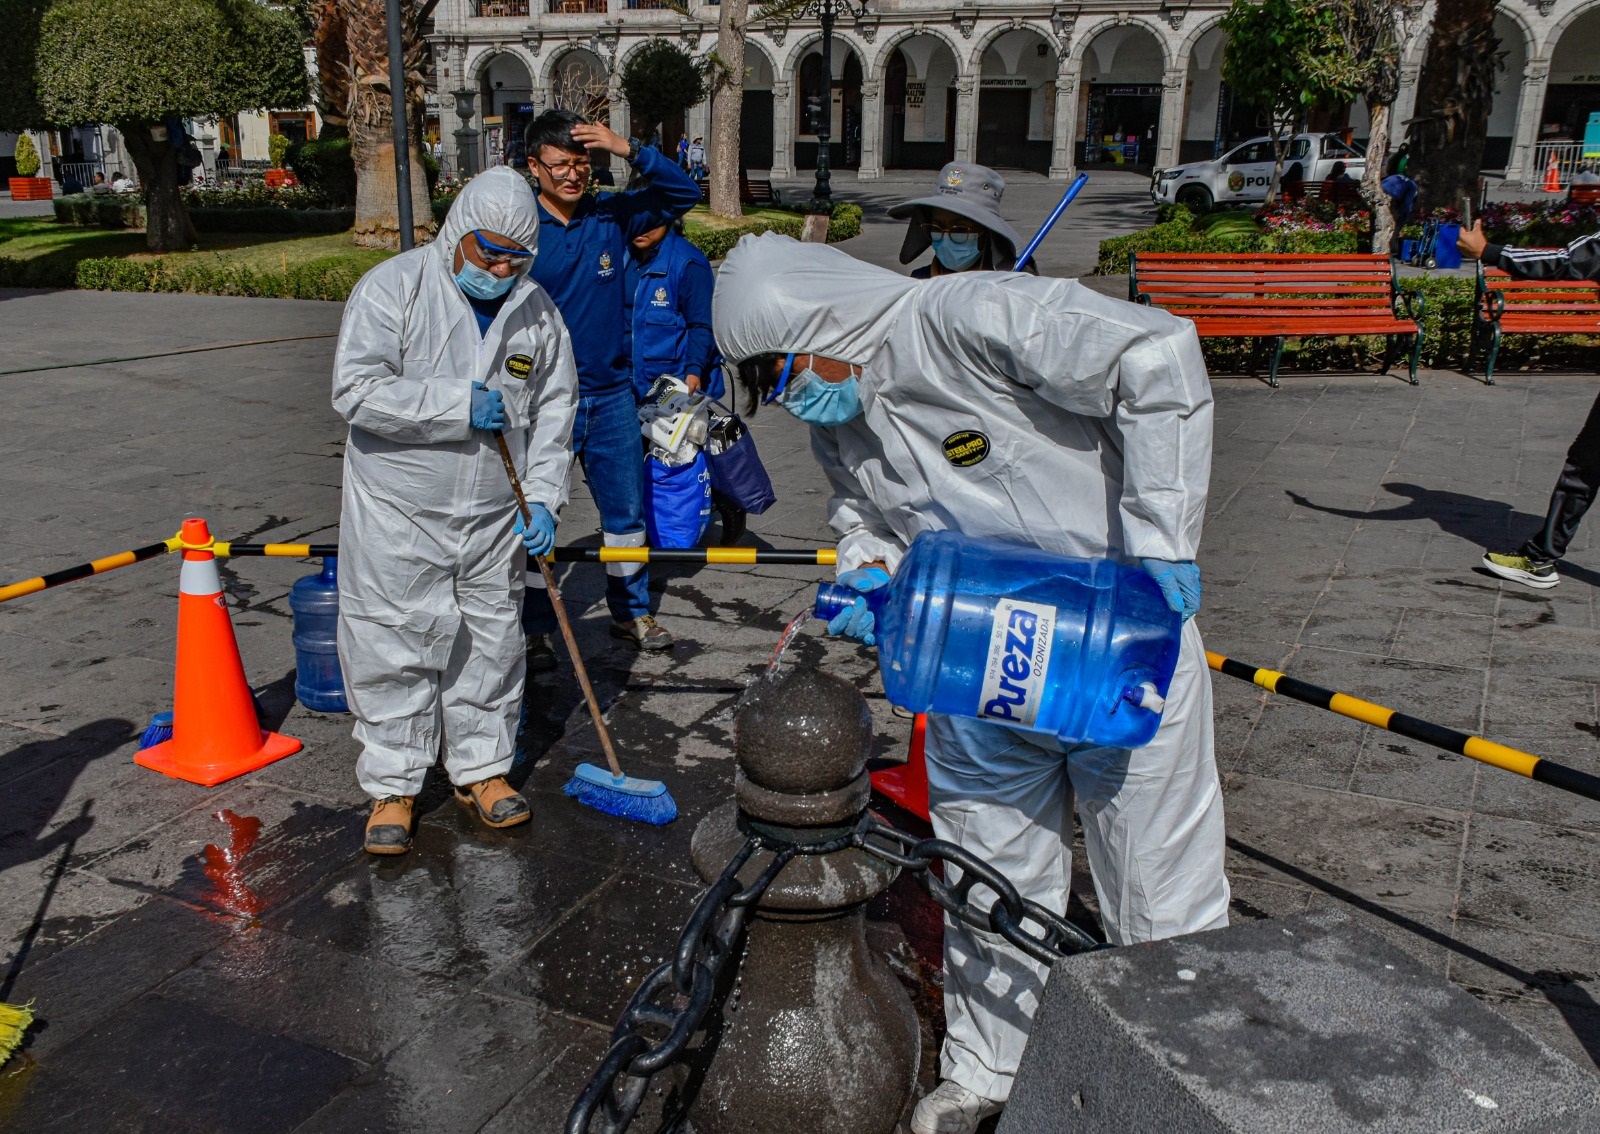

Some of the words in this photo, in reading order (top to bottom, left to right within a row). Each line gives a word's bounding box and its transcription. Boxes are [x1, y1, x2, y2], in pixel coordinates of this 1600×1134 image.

[946, 437, 983, 457] STEELPRO
[984, 609, 1038, 723] Pureza
[1033, 618, 1050, 677] OZONIZADA
